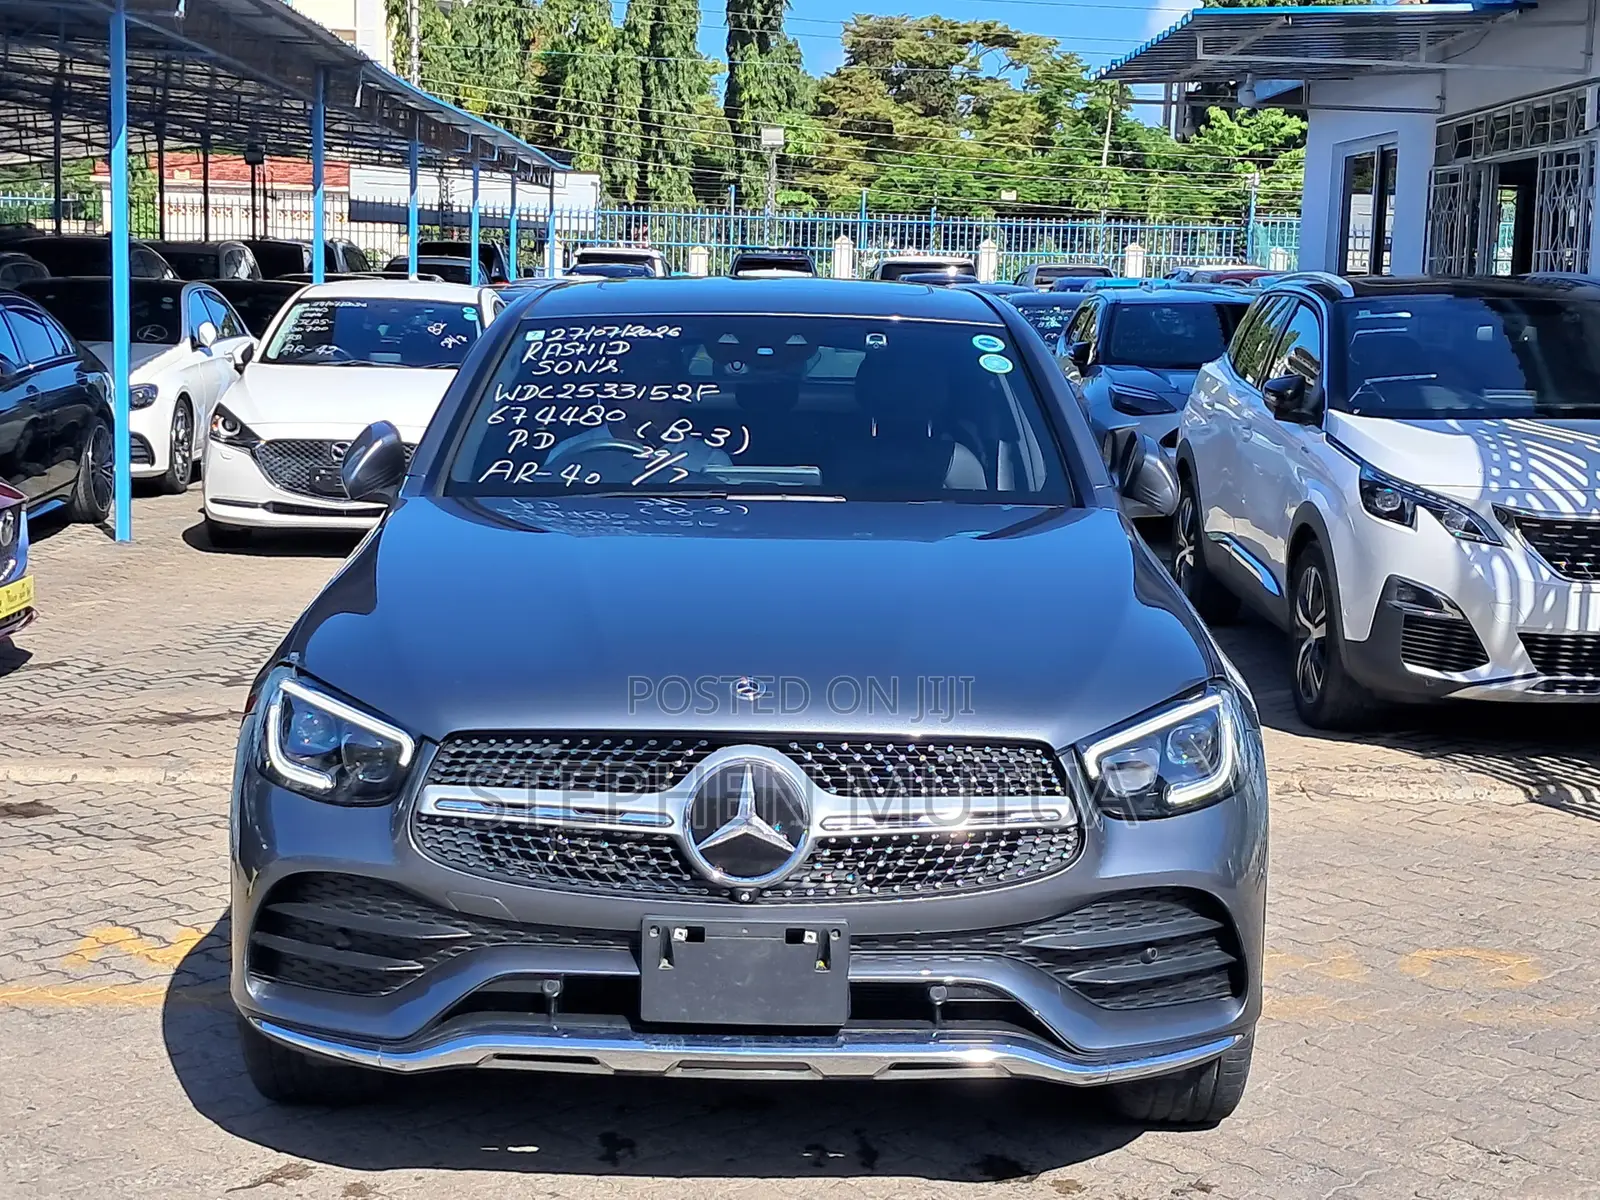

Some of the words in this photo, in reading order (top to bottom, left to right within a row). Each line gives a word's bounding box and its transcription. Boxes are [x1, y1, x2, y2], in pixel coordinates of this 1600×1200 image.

[545, 324, 682, 343] 27/07/2026
[521, 340, 631, 364] RASHID
[495, 382, 720, 402] WDC2533152F
[487, 404, 627, 427] 674480
